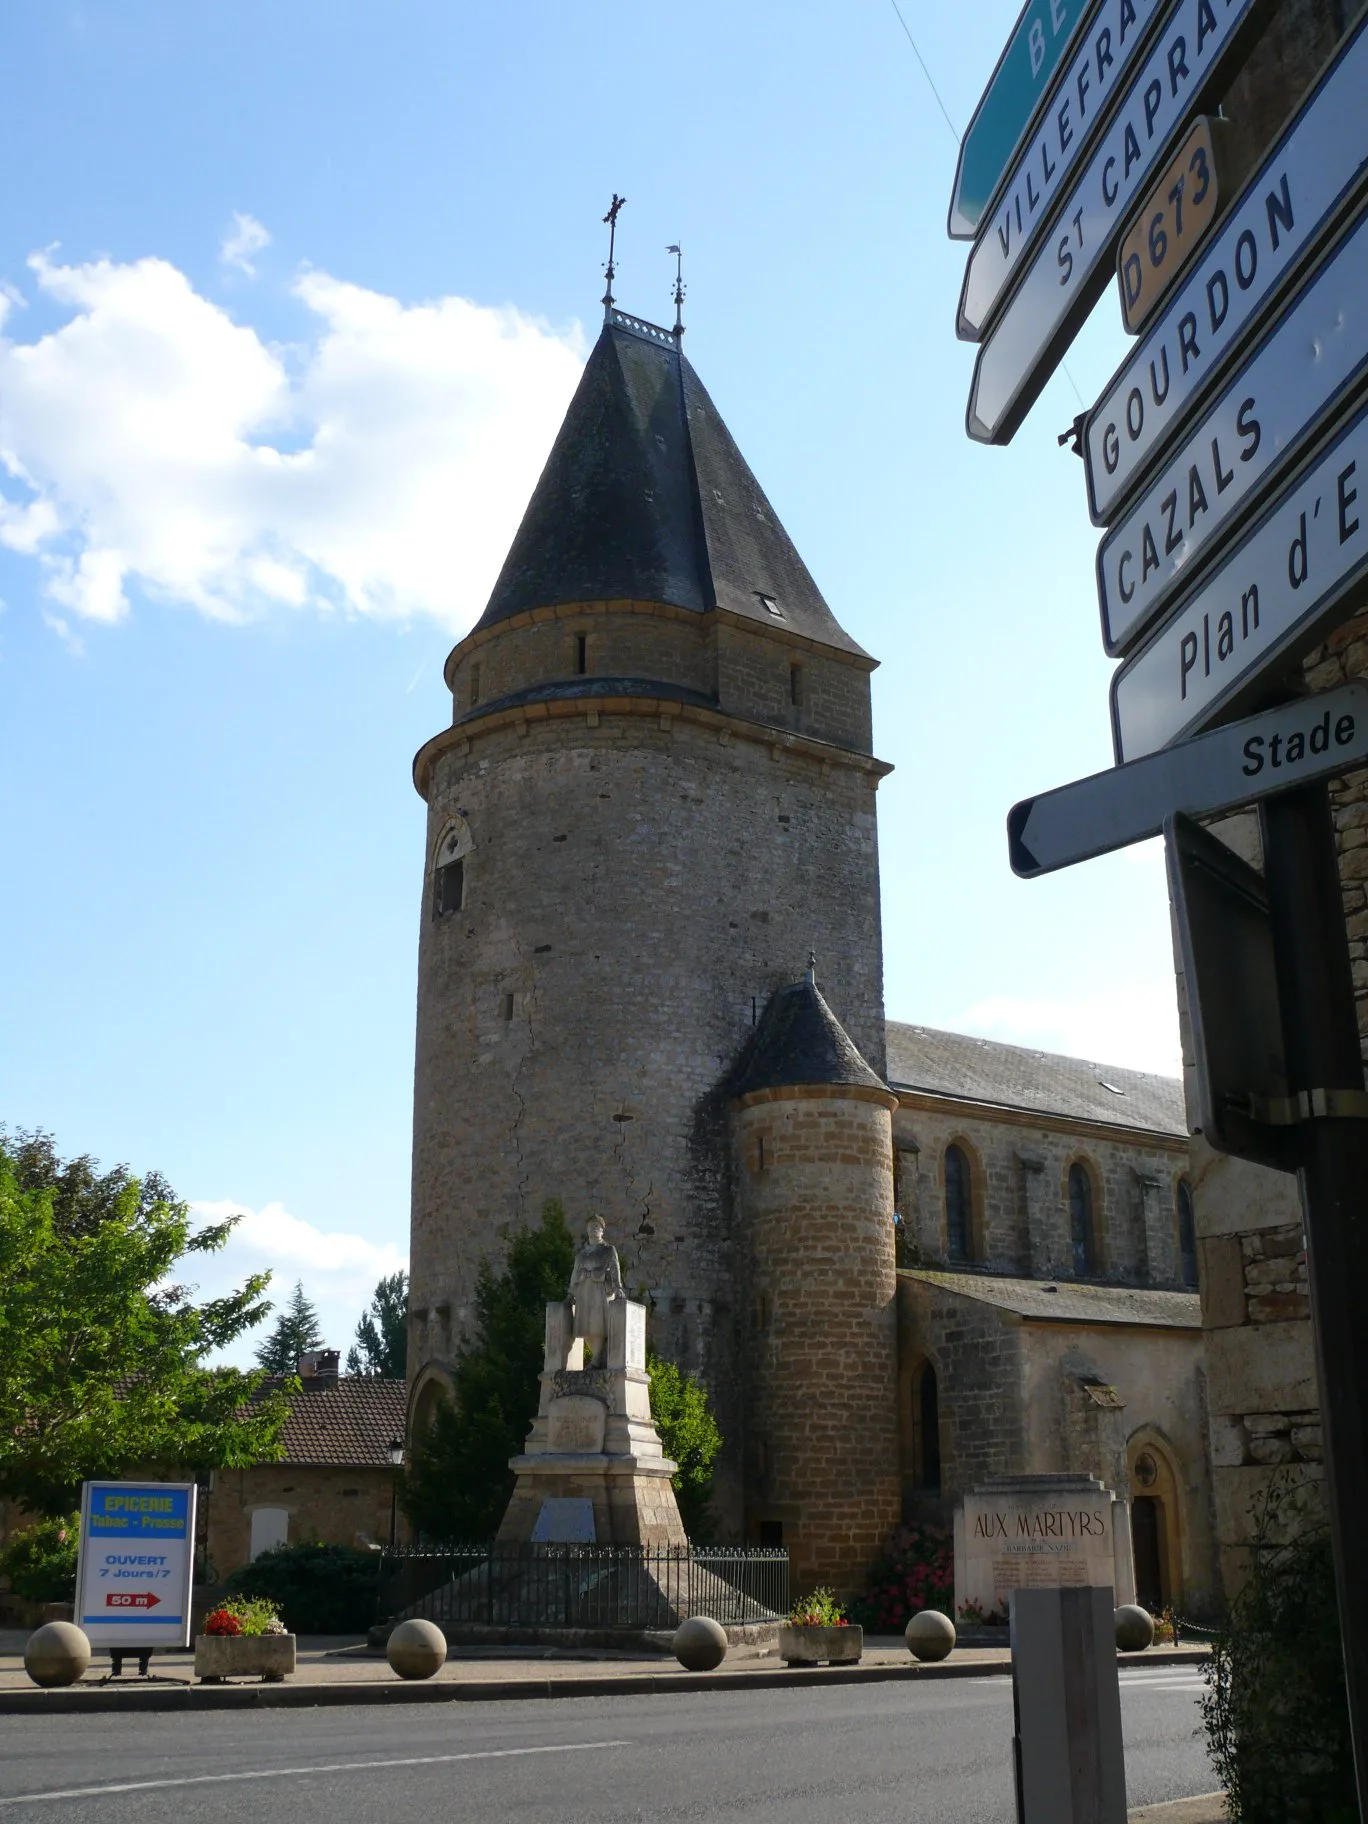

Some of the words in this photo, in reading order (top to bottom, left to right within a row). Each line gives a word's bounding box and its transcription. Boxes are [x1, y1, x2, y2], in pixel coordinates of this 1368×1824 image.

[997, 0, 1147, 260] VILLEFRA
[1057, 206, 1084, 286] ST
[1102, 0, 1233, 208] CAPRA
[1122, 147, 1211, 312] D673
[1102, 172, 1295, 474] GOURDON
[1118, 397, 1261, 604] CAZALS
[1180, 583, 1260, 701] Plan
[1242, 711, 1355, 777] Stade
[104, 1496, 174, 1513] EPICERIE
[973, 1512, 1008, 1539] AUX
[1016, 1510, 1105, 1538] MARTYRS
[100, 1568, 109, 1577] 7
[105, 1555, 167, 1566] OUVERT
[111, 1596, 132, 1605] 50
[135, 1597, 148, 1605] m
